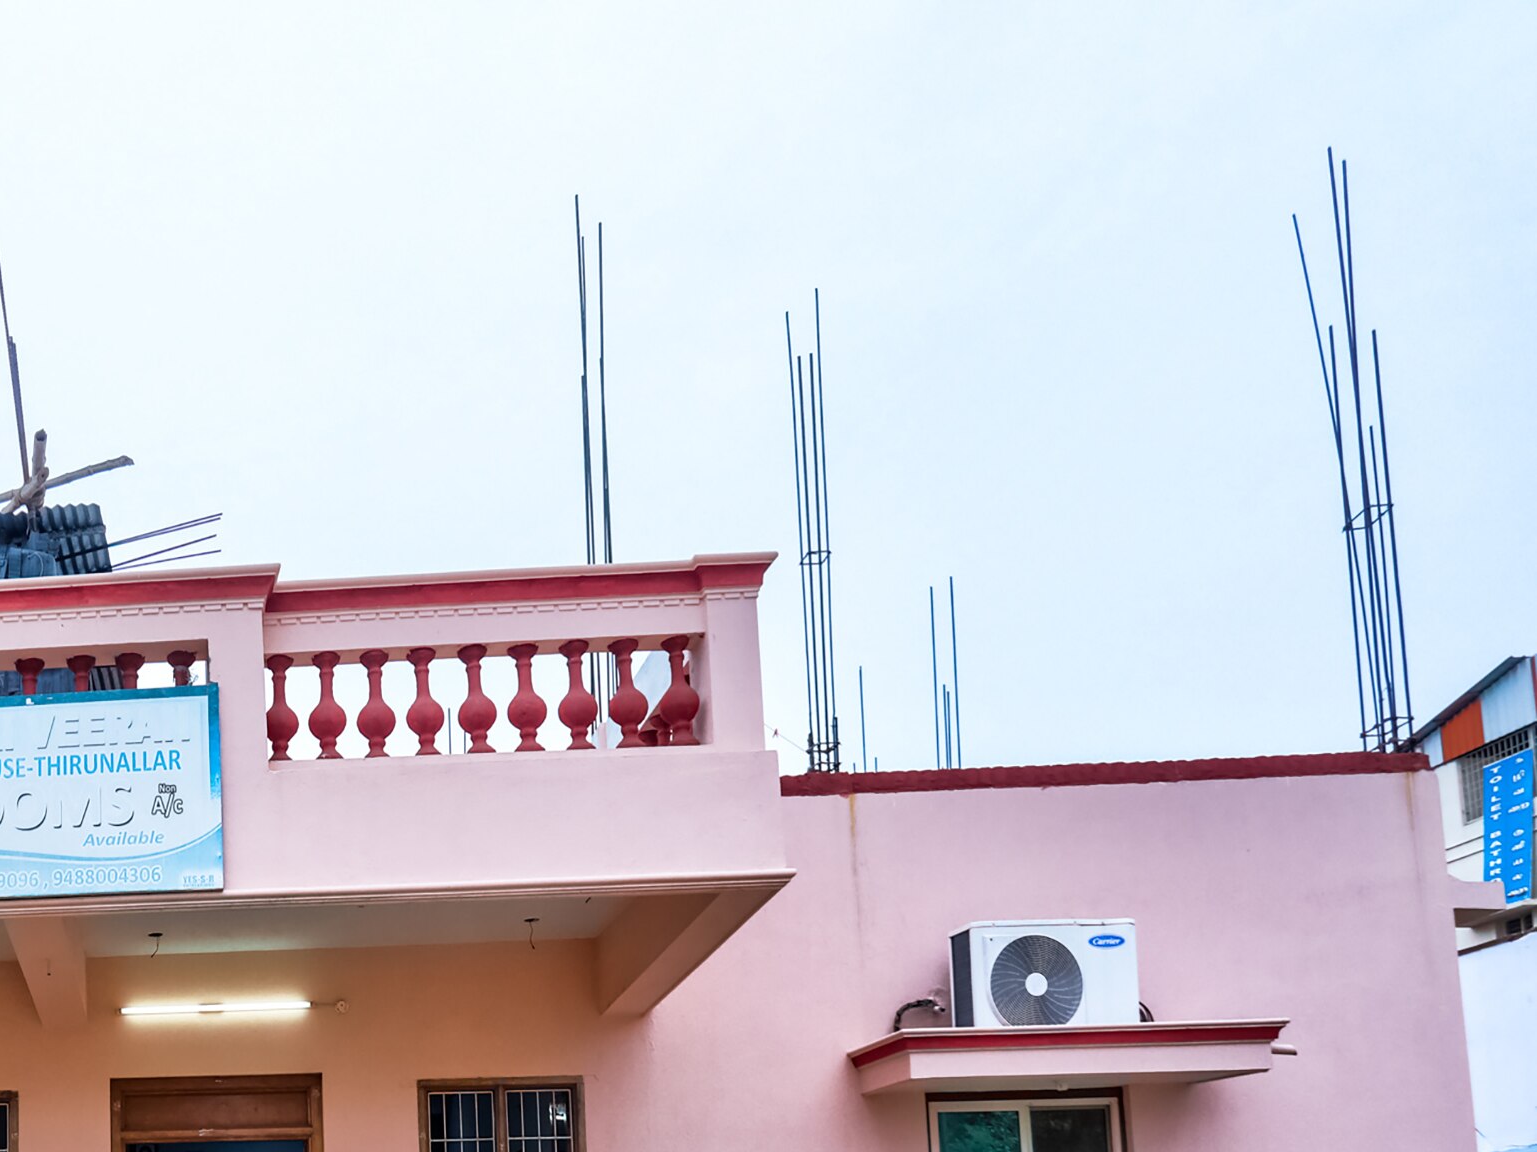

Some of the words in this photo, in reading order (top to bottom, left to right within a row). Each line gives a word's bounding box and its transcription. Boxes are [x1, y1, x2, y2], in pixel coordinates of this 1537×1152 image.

[158, 783, 176, 794] Non
[1489, 765, 1502, 821] TOILET
[151, 793, 184, 819] A/c
[83, 831, 165, 848] Available
[53, 866, 161, 887] 9488004306
[1092, 936, 1122, 946] Carrier
